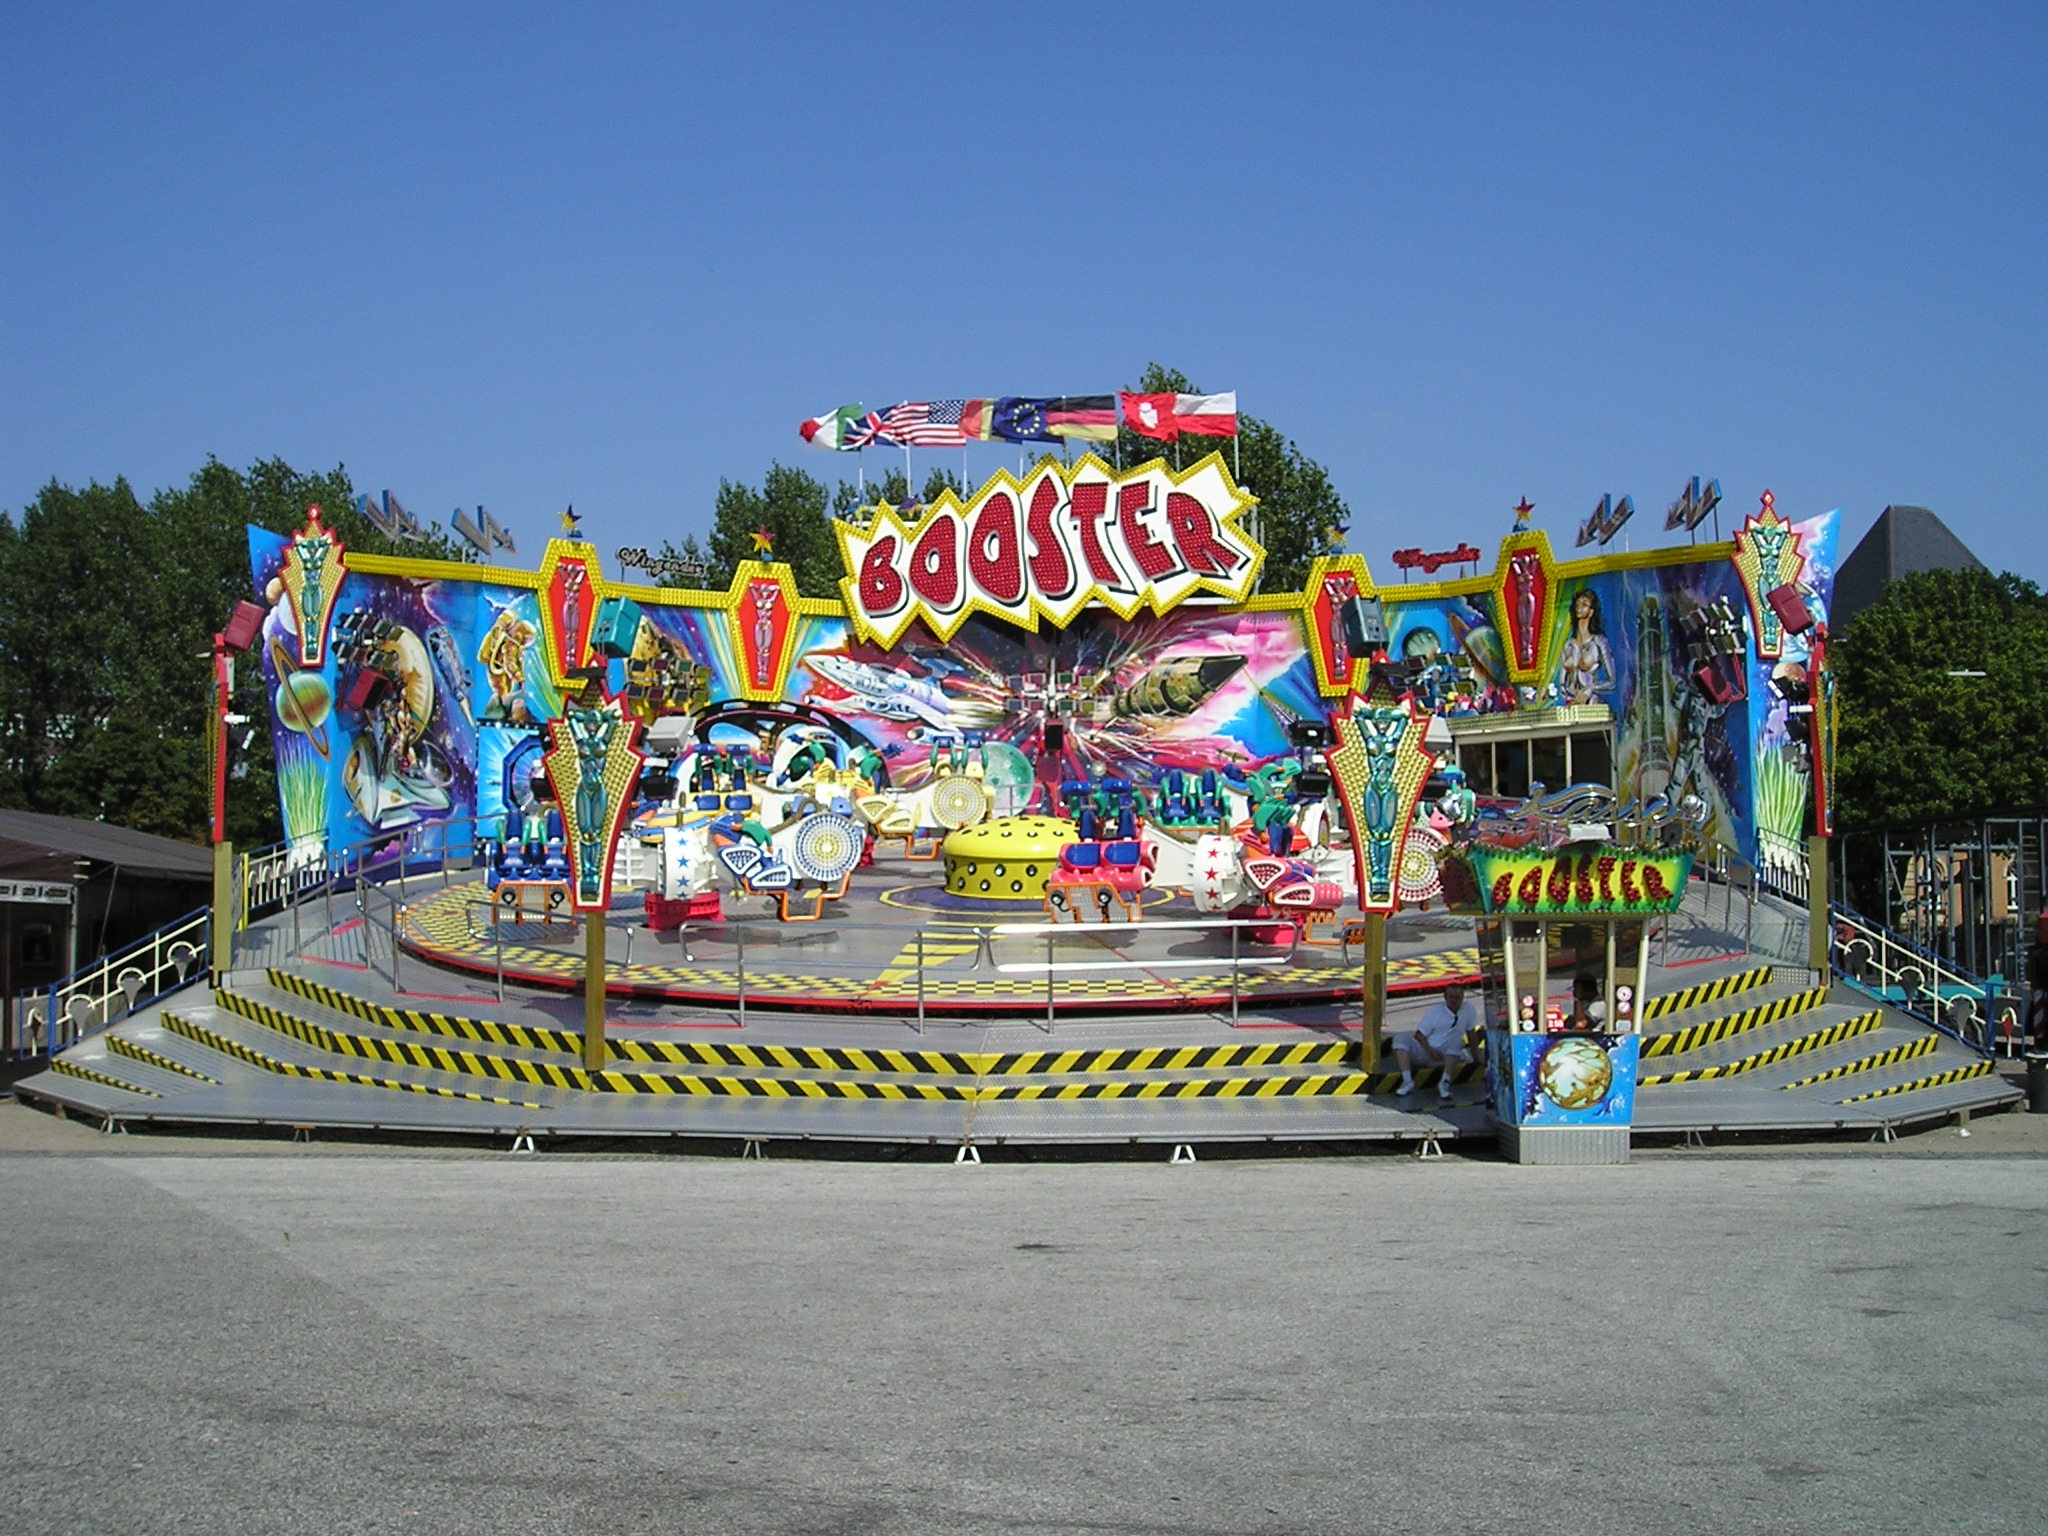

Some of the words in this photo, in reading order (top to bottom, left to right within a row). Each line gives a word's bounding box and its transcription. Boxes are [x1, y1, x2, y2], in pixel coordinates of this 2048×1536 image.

[859, 475, 1248, 617] BOOSTER
[1505, 781, 1681, 828] Kasse
[1491, 853, 1675, 905] BOOSTER
